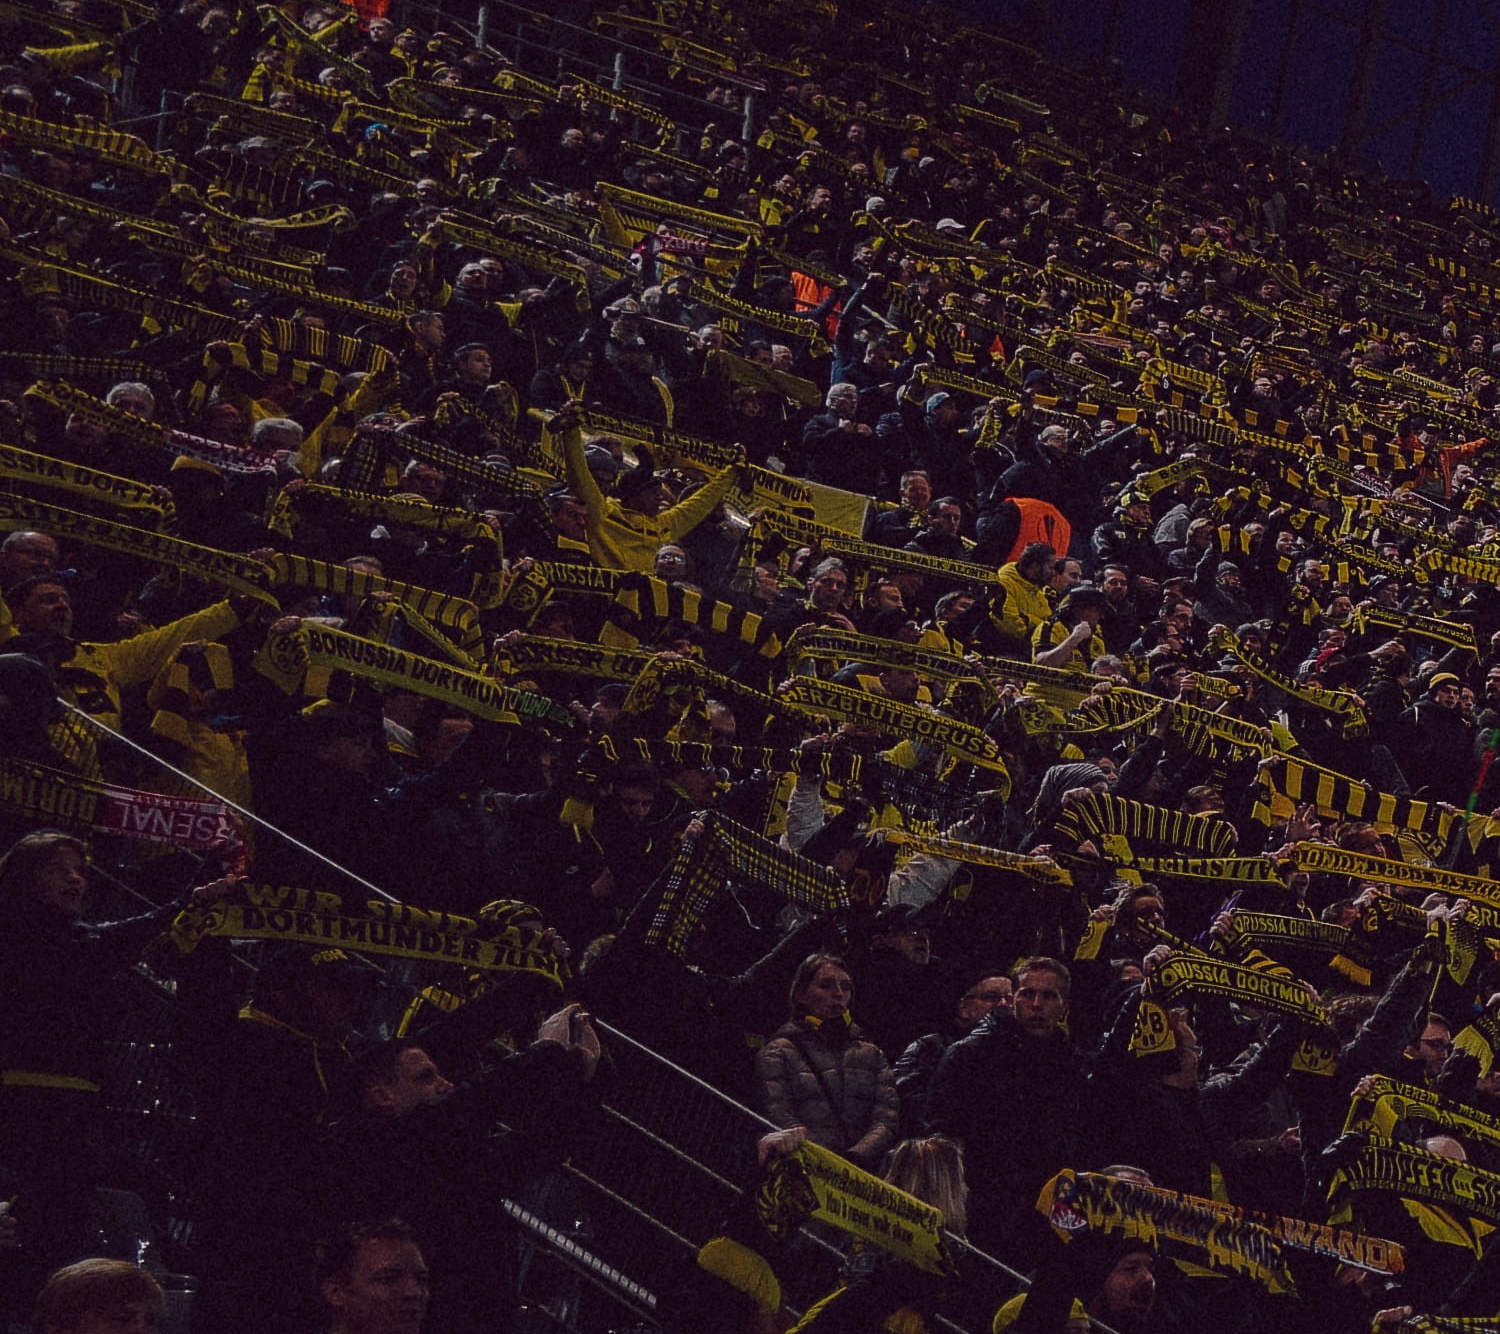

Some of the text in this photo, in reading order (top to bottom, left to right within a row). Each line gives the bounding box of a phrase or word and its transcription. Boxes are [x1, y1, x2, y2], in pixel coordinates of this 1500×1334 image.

[310, 628, 410, 679] BORUSSIA
[245, 881, 477, 933] WIR SIND
[243, 905, 479, 964] DORTMUNDER
